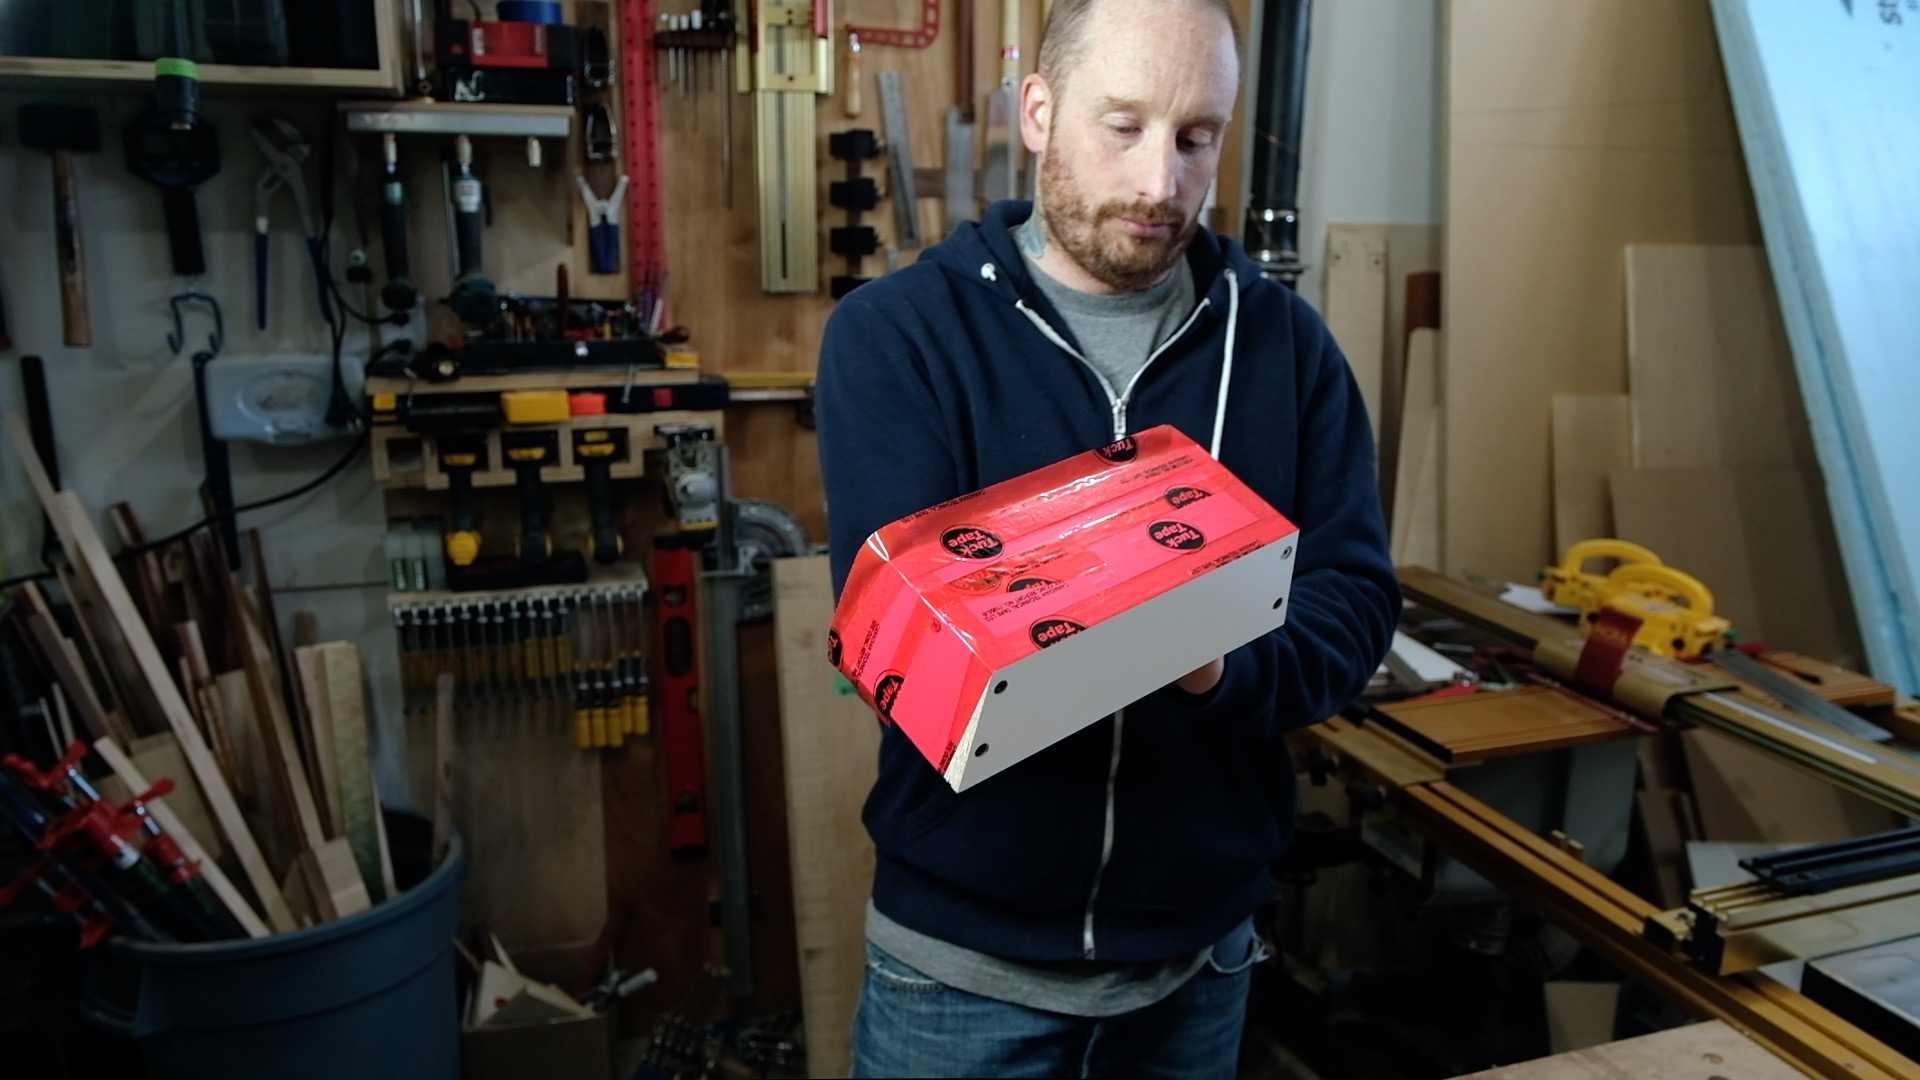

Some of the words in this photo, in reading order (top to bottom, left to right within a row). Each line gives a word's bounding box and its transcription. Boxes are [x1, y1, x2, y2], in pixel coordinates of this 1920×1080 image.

[1102, 438, 1134, 458] Tuck
[1171, 489, 1204, 505] Tape
[947, 530, 985, 547] Tape
[1154, 523, 1187, 540] Tape
[1166, 530, 1200, 547] Tuck
[959, 538, 999, 557] Tuck
[1037, 622, 1076, 642] Tape
[880, 677, 899, 710] Tape
